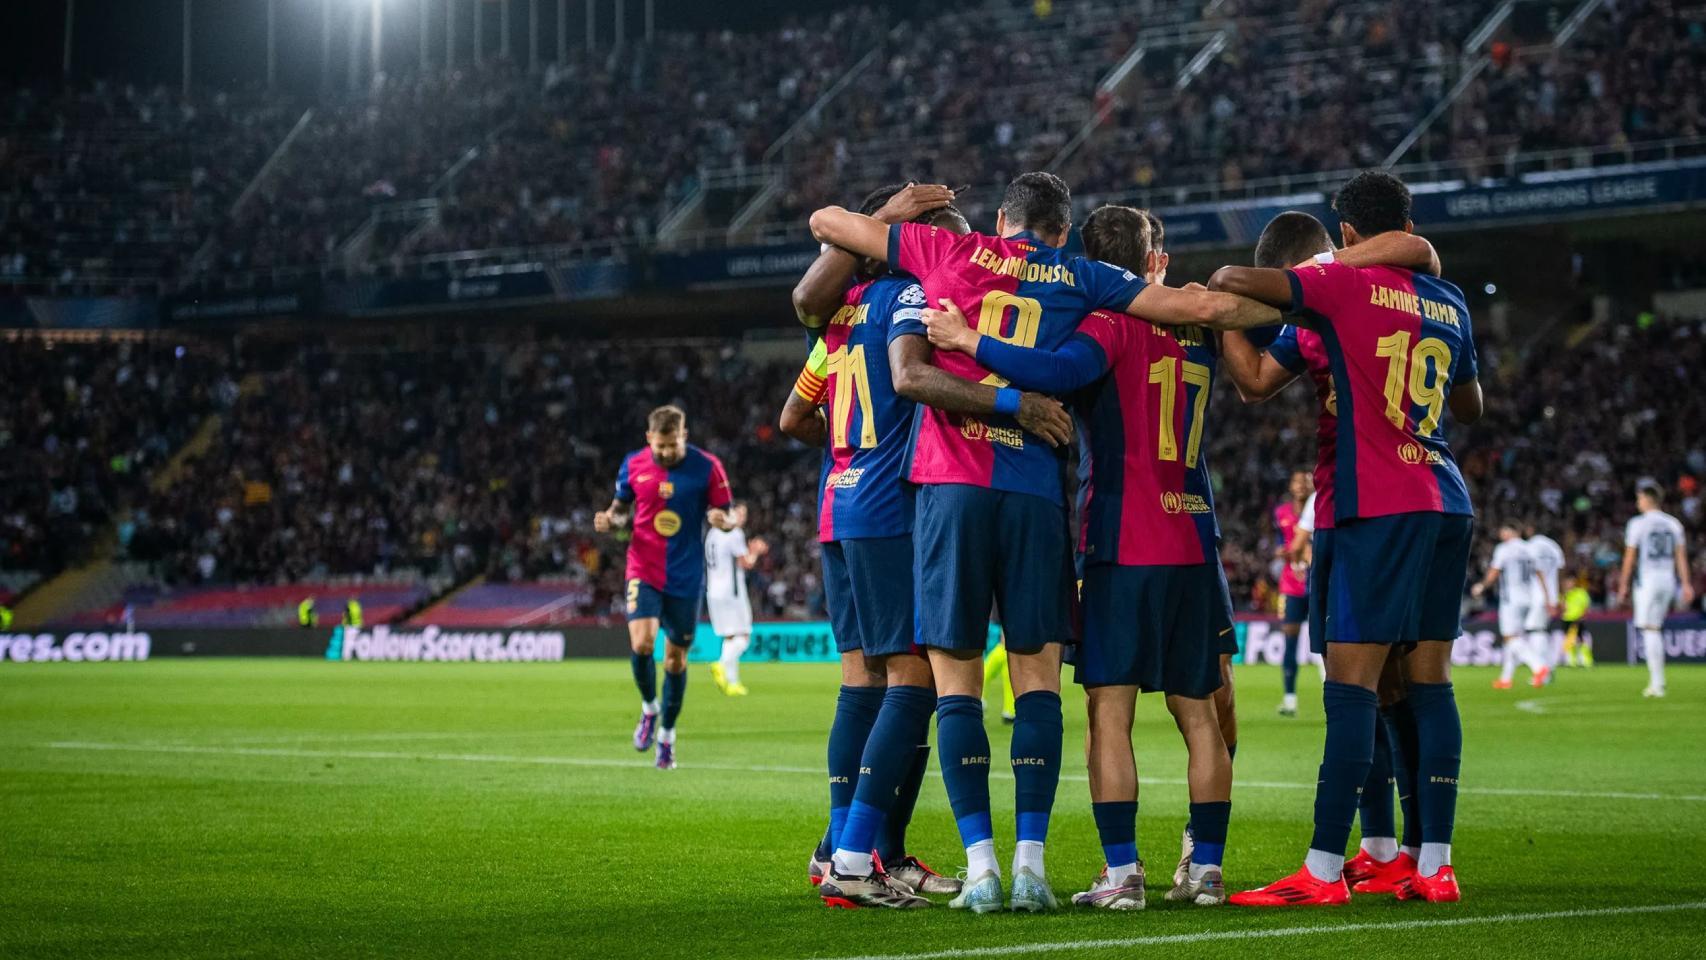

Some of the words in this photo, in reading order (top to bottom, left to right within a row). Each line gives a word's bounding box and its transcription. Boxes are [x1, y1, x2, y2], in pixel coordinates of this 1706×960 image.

[1591, 177, 1657, 204] LEAGUE
[969, 246, 1076, 287] LEWANDOWSKI
[1369, 284, 1422, 316] LAMINE
[827, 343, 878, 449] 11
[1375, 329, 1452, 438] 19
[1148, 355, 1210, 469] 17
[626, 578, 641, 603] 5
[341, 624, 566, 662] FollowScores.com
